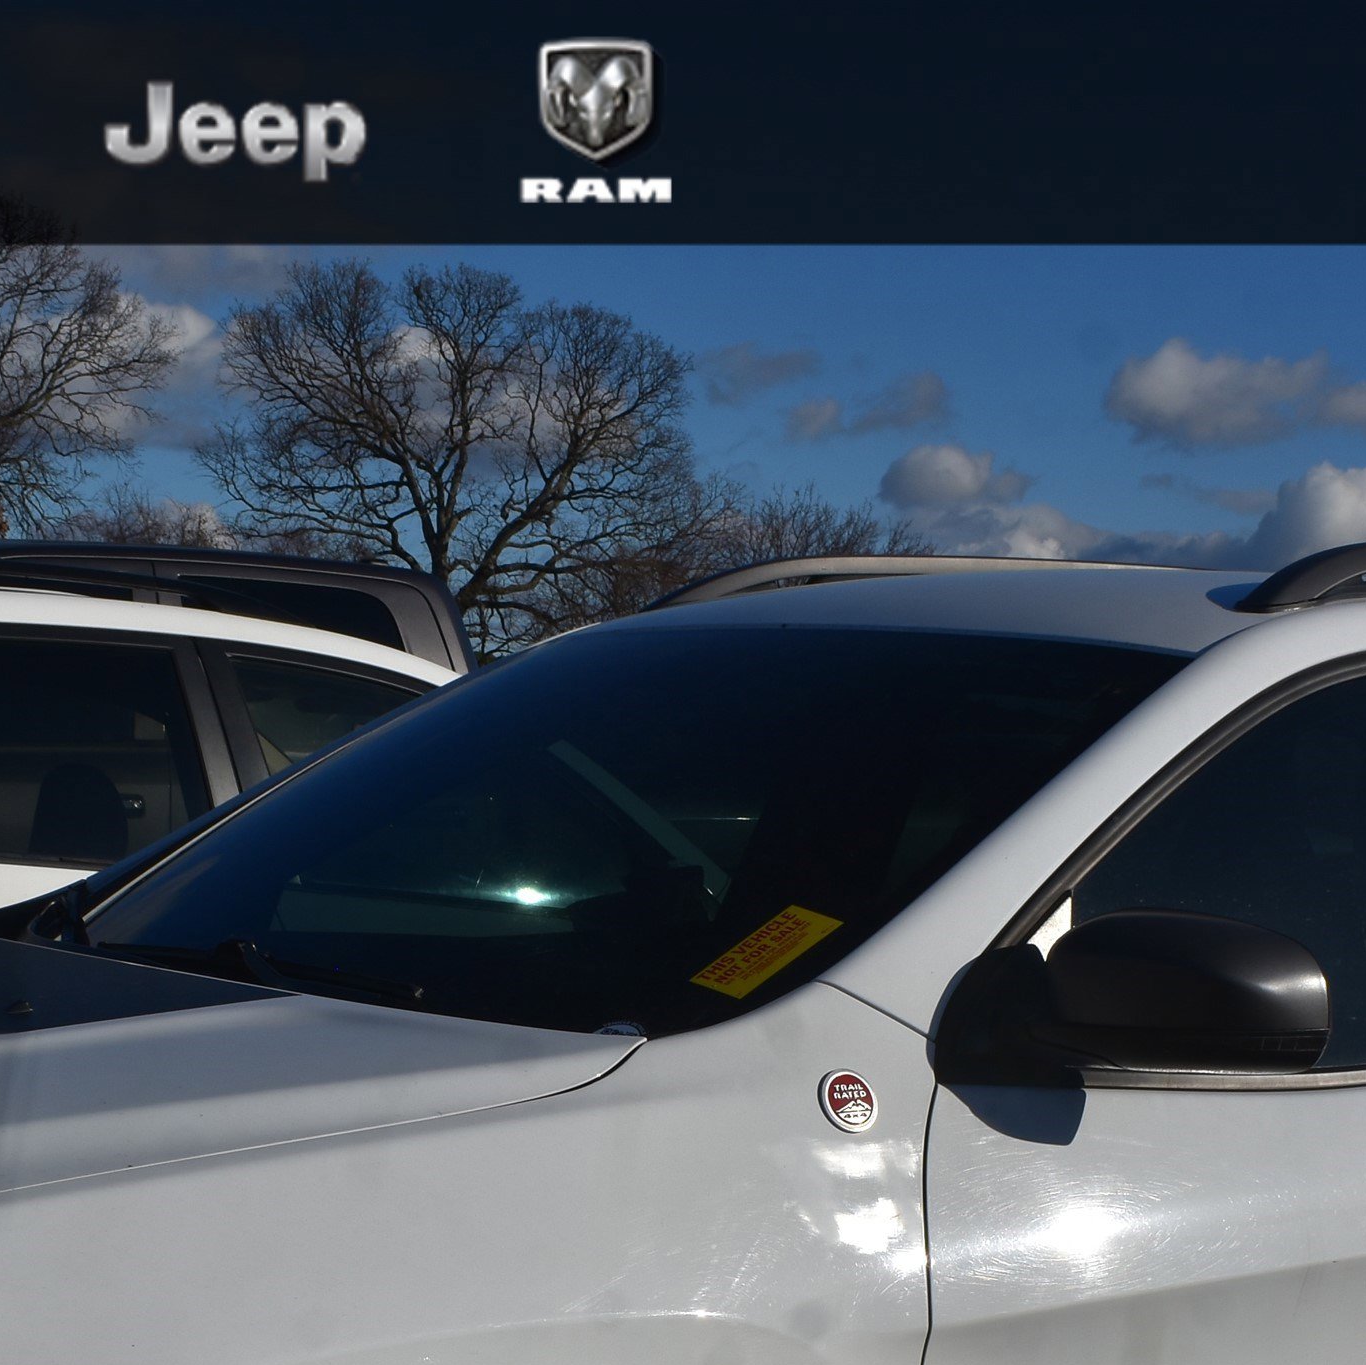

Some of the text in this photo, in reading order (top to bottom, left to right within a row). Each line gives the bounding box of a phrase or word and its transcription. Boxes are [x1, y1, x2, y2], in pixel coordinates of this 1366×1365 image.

[696, 956, 735, 980] THIS
[734, 911, 797, 955] VEHICLE
[714, 965, 742, 984] NOT
[742, 943, 771, 964] FOR
[770, 918, 806, 943] SALE
[833, 1083, 864, 1092] TRAIL
[833, 1091, 867, 1100] RATED
